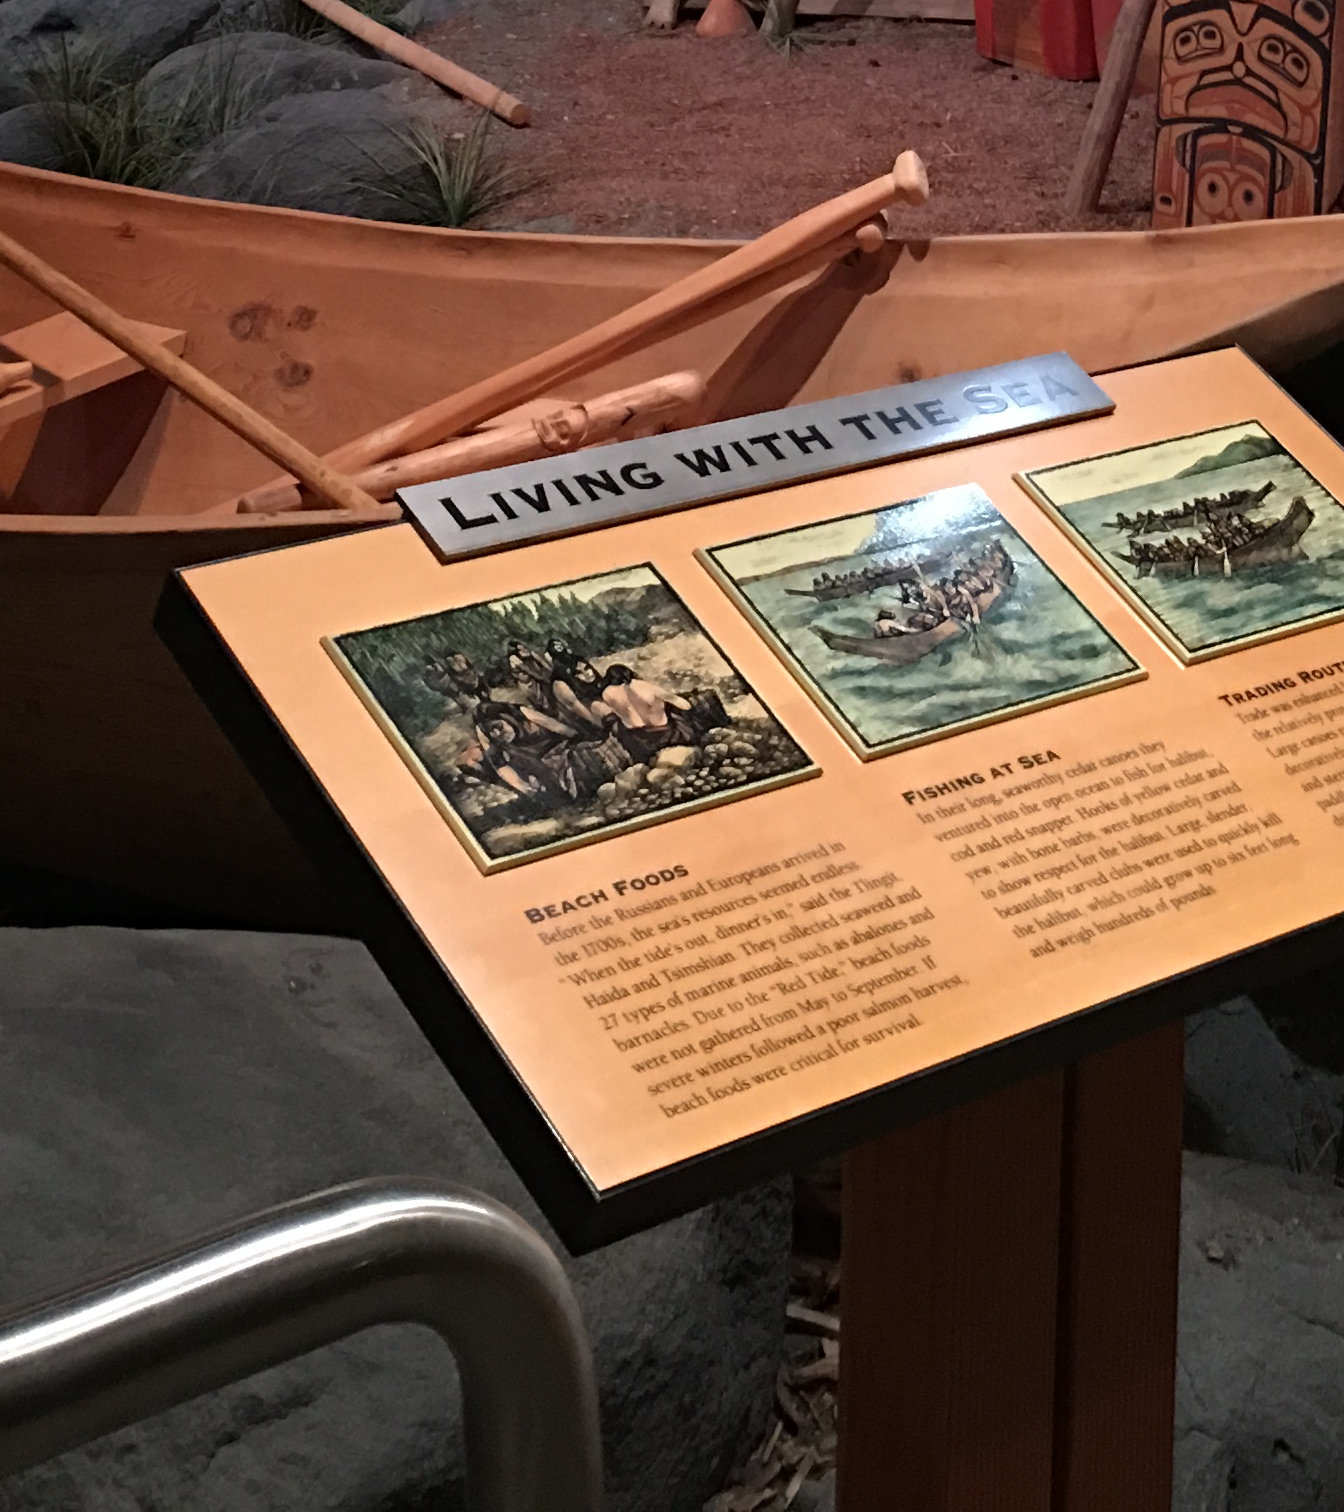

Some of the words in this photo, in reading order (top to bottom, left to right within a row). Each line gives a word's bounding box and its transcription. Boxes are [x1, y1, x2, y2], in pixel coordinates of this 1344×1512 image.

[440, 461, 664, 530] LIVING
[674, 424, 833, 478] WITH
[839, 398, 958, 441] THE
[961, 374, 1082, 416] SEA
[1217, 677, 1298, 708] TRADING
[900, 772, 987, 807] FISHING
[989, 762, 1015, 780] AT
[1016, 749, 1062, 770] SEA
[915, 811, 937, 826] In
[933, 801, 968, 820] their
[963, 792, 1005, 810] long,
[1000, 772, 1065, 800] seaworthy
[1064, 760, 1099, 779] cedar
[1097, 748, 1141, 769] canoes
[1137, 740, 1167, 756] they
[933, 814, 994, 843] ventured
[988, 809, 1021, 826] into
[1017, 801, 1043, 817] the
[1041, 792, 1075, 811] open
[1073, 780, 1112, 799] ocean
[1108, 775, 1126, 788] to
[1121, 765, 1151, 783] fish
[1145, 761, 1168, 776] for
[949, 843, 978, 863] cod
[975, 834, 1004, 855] and
[1000, 827, 1027, 846] red
[1074, 799, 1120, 821] Hooks
[1117, 791, 1135, 808] of
[1131, 781, 1173, 806] yellow
[1172, 771, 1207, 790] cedar
[1205, 760, 1231, 780] and
[992, 887, 1066, 920] beautifully
[1065, 870, 1111, 896] carved
[1108, 861, 1145, 882] clubs
[1141, 851, 1175, 869] were
[1172, 838, 1205, 859] used
[1201, 836, 1219, 849] to
[1216, 820, 1262, 846] quickly
[1256, 811, 1284, 830] kill
[996, 850, 1030, 870] with
[1025, 842, 1063, 861] bone
[1099, 819, 1132, 836] were
[1130, 794, 1204, 827] decoratively
[1202, 779, 1243, 803] carved
[523, 888, 610, 925] BEACH
[611, 864, 690, 897] FOODS
[536, 922, 589, 947] Before
[587, 914, 615, 931] the
[612, 894, 680, 923] Russians
[678, 881, 710, 903] and
[704, 862, 783, 893] Europeans
[780, 842, 832, 870] arrived
[826, 841, 847, 855] in
[979, 887, 998, 901] to
[996, 875, 1033, 896] show
[1031, 859, 1080, 883] respect
[1074, 852, 1099, 868] for
[1097, 845, 1122, 861] the
[1011, 923, 1038, 940] the
[1085, 889, 1128, 913] which
[1125, 875, 1165, 900] could
[1162, 868, 1194, 891] grow
[1193, 861, 1214, 877] up
[1210, 856, 1229, 869] to
[1226, 851, 1248, 865] six
[1242, 841, 1271, 858] feet
[1264, 832, 1301, 850] long
[553, 950, 582, 967] the
[629, 926, 657, 943] the
[656, 915, 692, 935] sea's
[690, 893, 759, 923] resources
[757, 873, 812, 902] seemed
[581, 984, 633, 1010] Haida
[630, 972, 663, 995] and
[737, 937, 778, 958] They
[777, 912, 841, 945] collected
[838, 894, 897, 924] seaweed
[895, 885, 924, 906] and
[616, 956, 644, 973] the
[642, 942, 685, 964] tide's
[714, 913, 773, 941] dinner's
[798, 891, 830, 913] said
[827, 886, 853, 903] the
[1028, 937, 1058, 959] and
[1054, 925, 1097, 949] weigh
[1091, 904, 1157, 935] hundreds
[1154, 896, 1171, 914] of
[597, 1012, 620, 1032] 27
[621, 1000, 667, 1025] types
[665, 989, 686, 1009] of
[682, 976, 739, 1003] marine
[796, 941, 835, 964] such
[831, 938, 851, 952] as
[848, 919, 909, 947] abalones
[907, 905, 936, 926] and
[630, 1053, 671, 1074] were
[668, 1042, 699, 1062] not
[697, 1016, 763, 1055] gathered
[758, 1007, 801, 1029] from
[795, 996, 831, 1015] May
[829, 989, 850, 1004] to
[920, 953, 938, 971] If
[690, 1006, 727, 1026] Due
[725, 999, 745, 1014] to
[743, 991, 771, 1008] the
[846, 946, 894, 971] beach
[888, 934, 932, 957] foods
[646, 1071, 696, 1098] severe
[694, 1050, 754, 1079] winters
[748, 1023, 817, 1059] followed
[814, 1023, 828, 1037] a
[825, 1011, 862, 1037] poor
[860, 992, 914, 1020] salmon
[657, 1091, 710, 1119] beach
[704, 1076, 753, 1102] foods
[749, 1064, 789, 1085] were
[788, 1041, 840, 1073] critical
[834, 1037, 861, 1055] for
